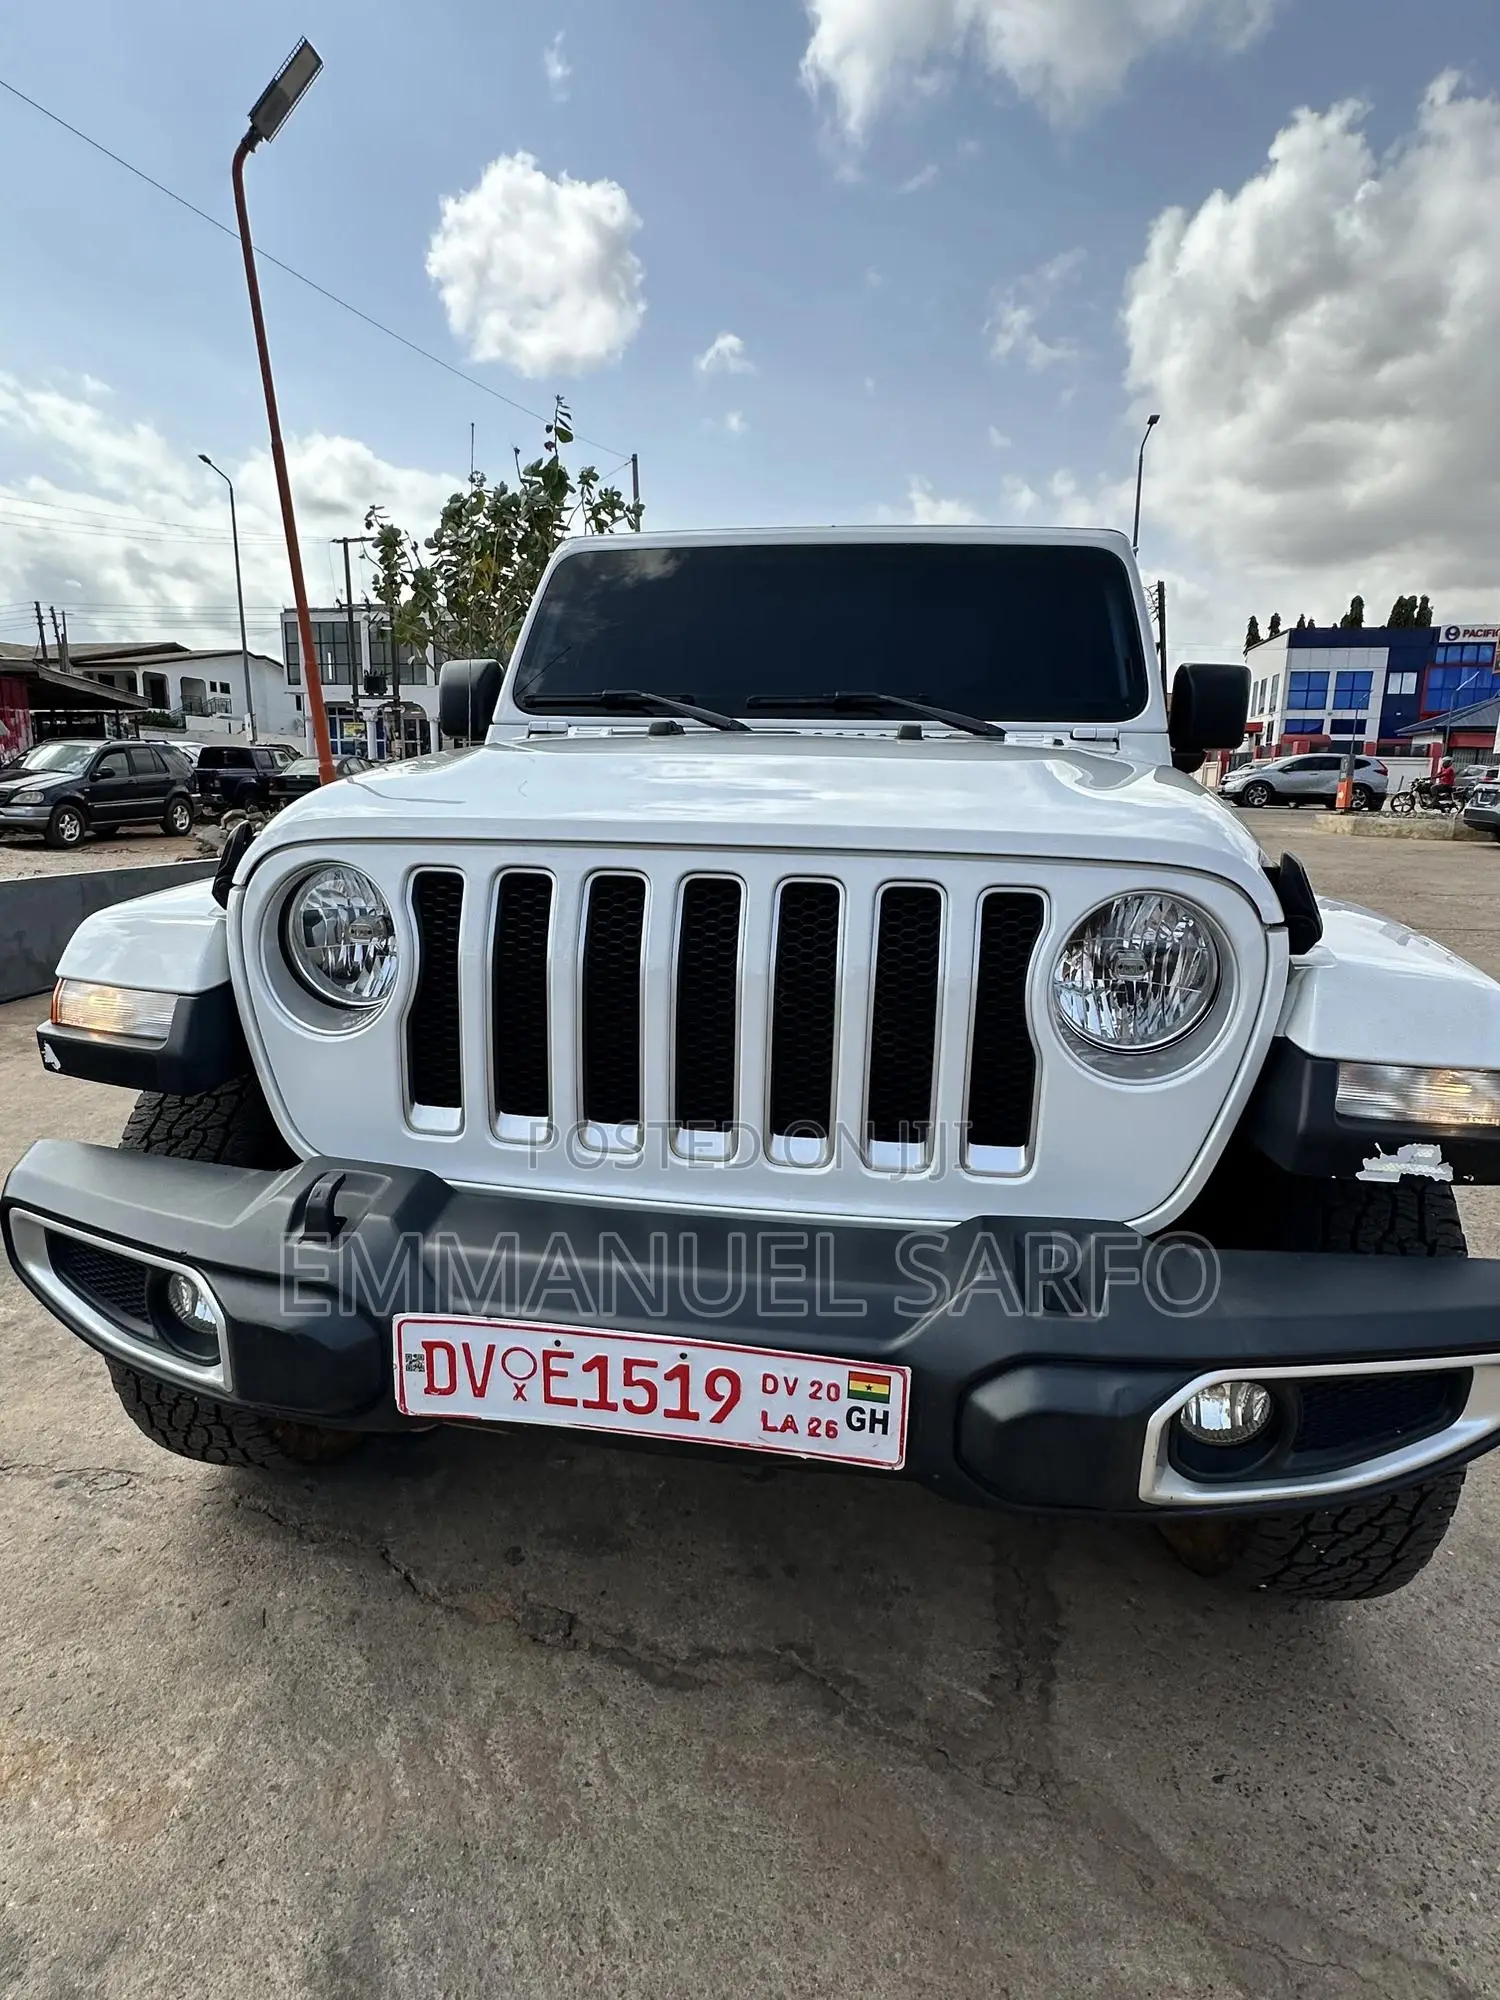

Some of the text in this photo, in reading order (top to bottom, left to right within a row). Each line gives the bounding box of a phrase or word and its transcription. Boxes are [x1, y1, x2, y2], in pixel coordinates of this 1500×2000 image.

[421, 1340, 742, 1424] DV E1519
[761, 1372, 841, 1402] DV 20
[761, 1409, 839, 1439] LA 26
[845, 1405, 890, 1436] GH
